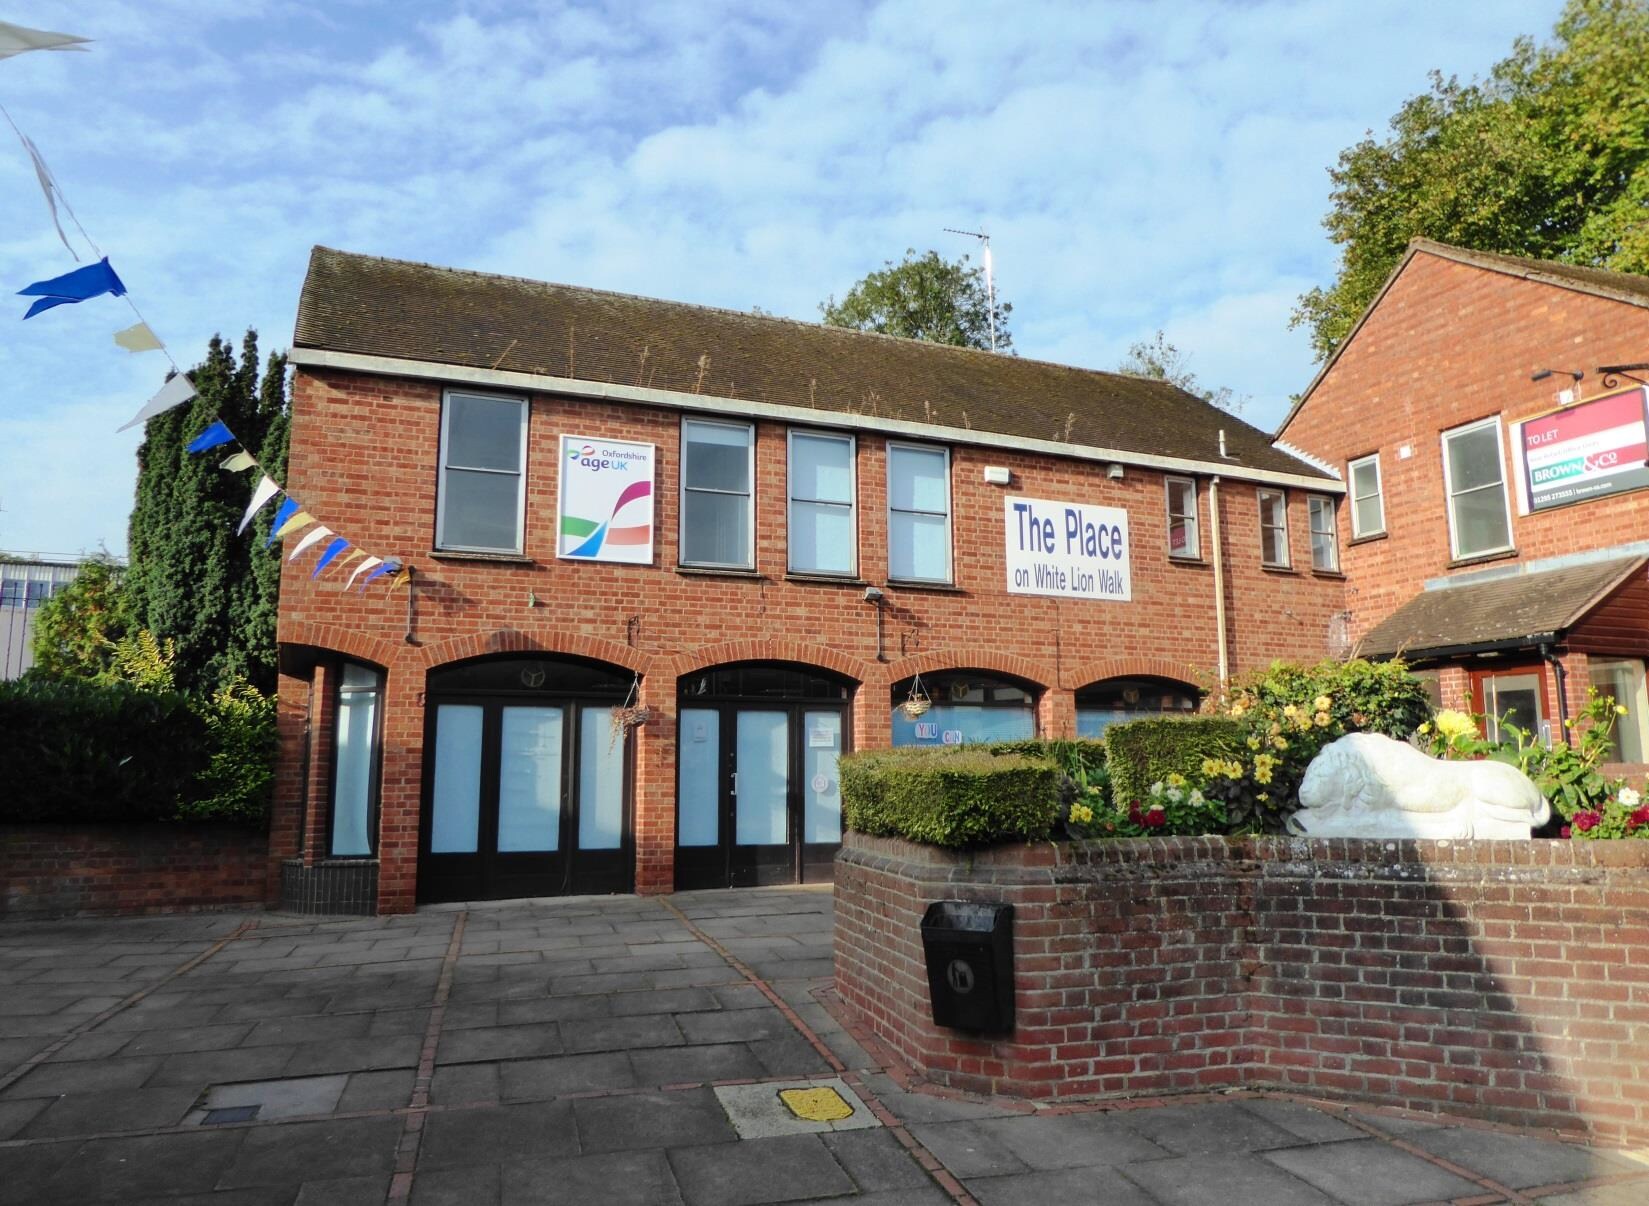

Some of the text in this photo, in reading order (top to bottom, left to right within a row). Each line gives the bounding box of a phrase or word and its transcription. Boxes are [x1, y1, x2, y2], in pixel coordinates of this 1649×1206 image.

[1527, 429, 1559, 446] TO LET
[602, 450, 647, 461] Oxfordshire
[581, 457, 628, 472] age UK
[1013, 503, 1123, 560] The Place
[1015, 563, 1124, 595] on White Lion Walk
